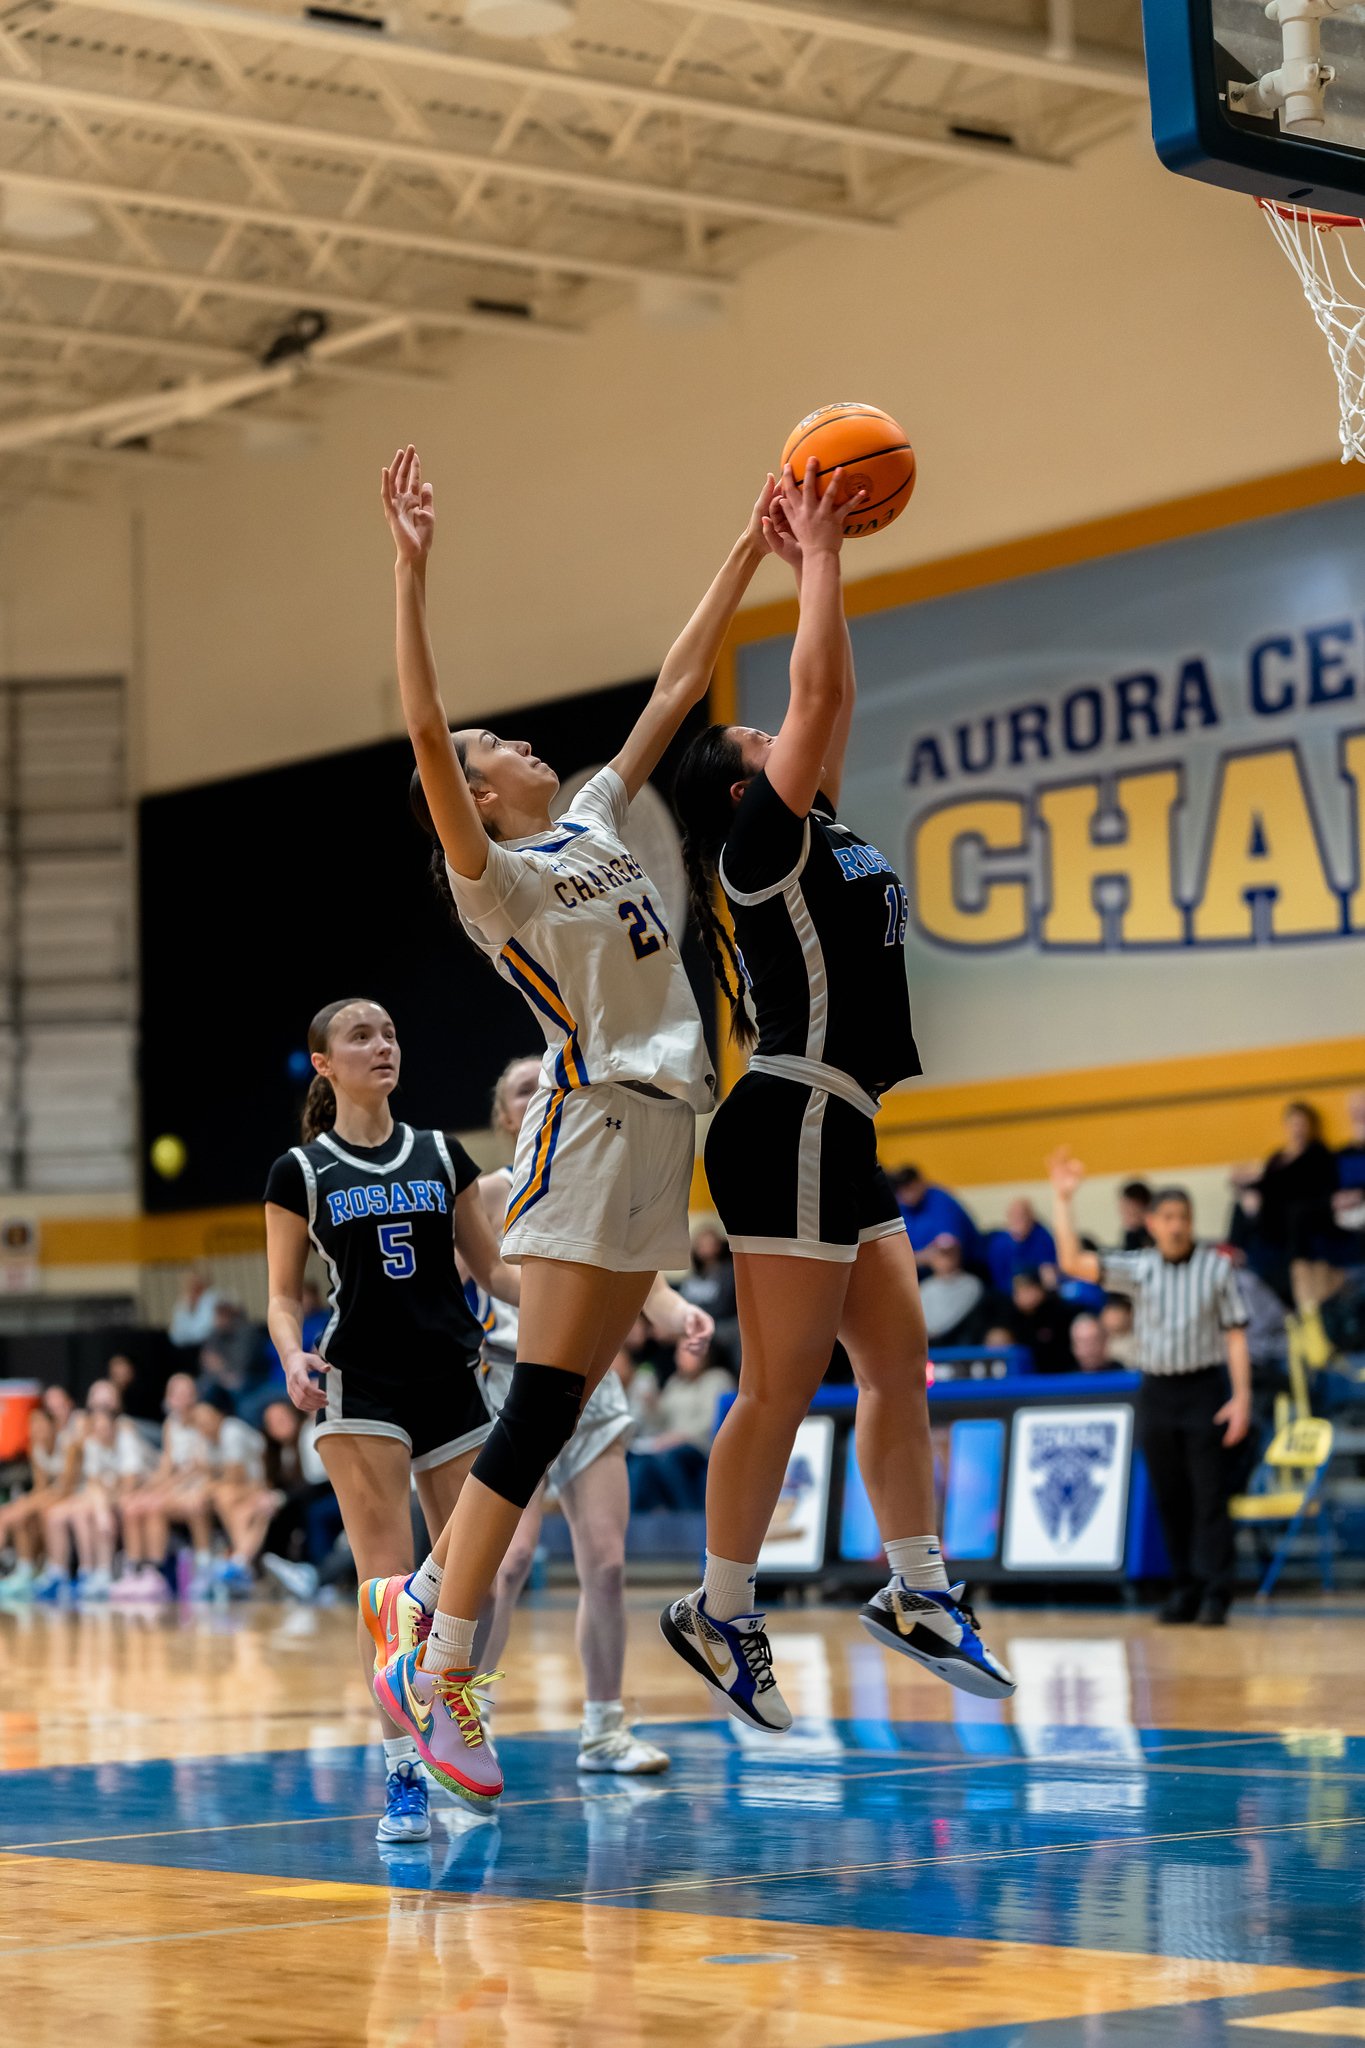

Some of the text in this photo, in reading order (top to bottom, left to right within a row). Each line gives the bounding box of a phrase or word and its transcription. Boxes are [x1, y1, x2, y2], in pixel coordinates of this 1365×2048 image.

[905, 616, 1365, 786] AURORA CE
[831, 844, 895, 881] ROS
[905, 727, 1365, 954] CHA
[554, 853, 648, 909] CHARGE
[618, 893, 669, 960] 21
[327, 1180, 447, 1226] ROSARY
[377, 1221, 417, 1280] 5
